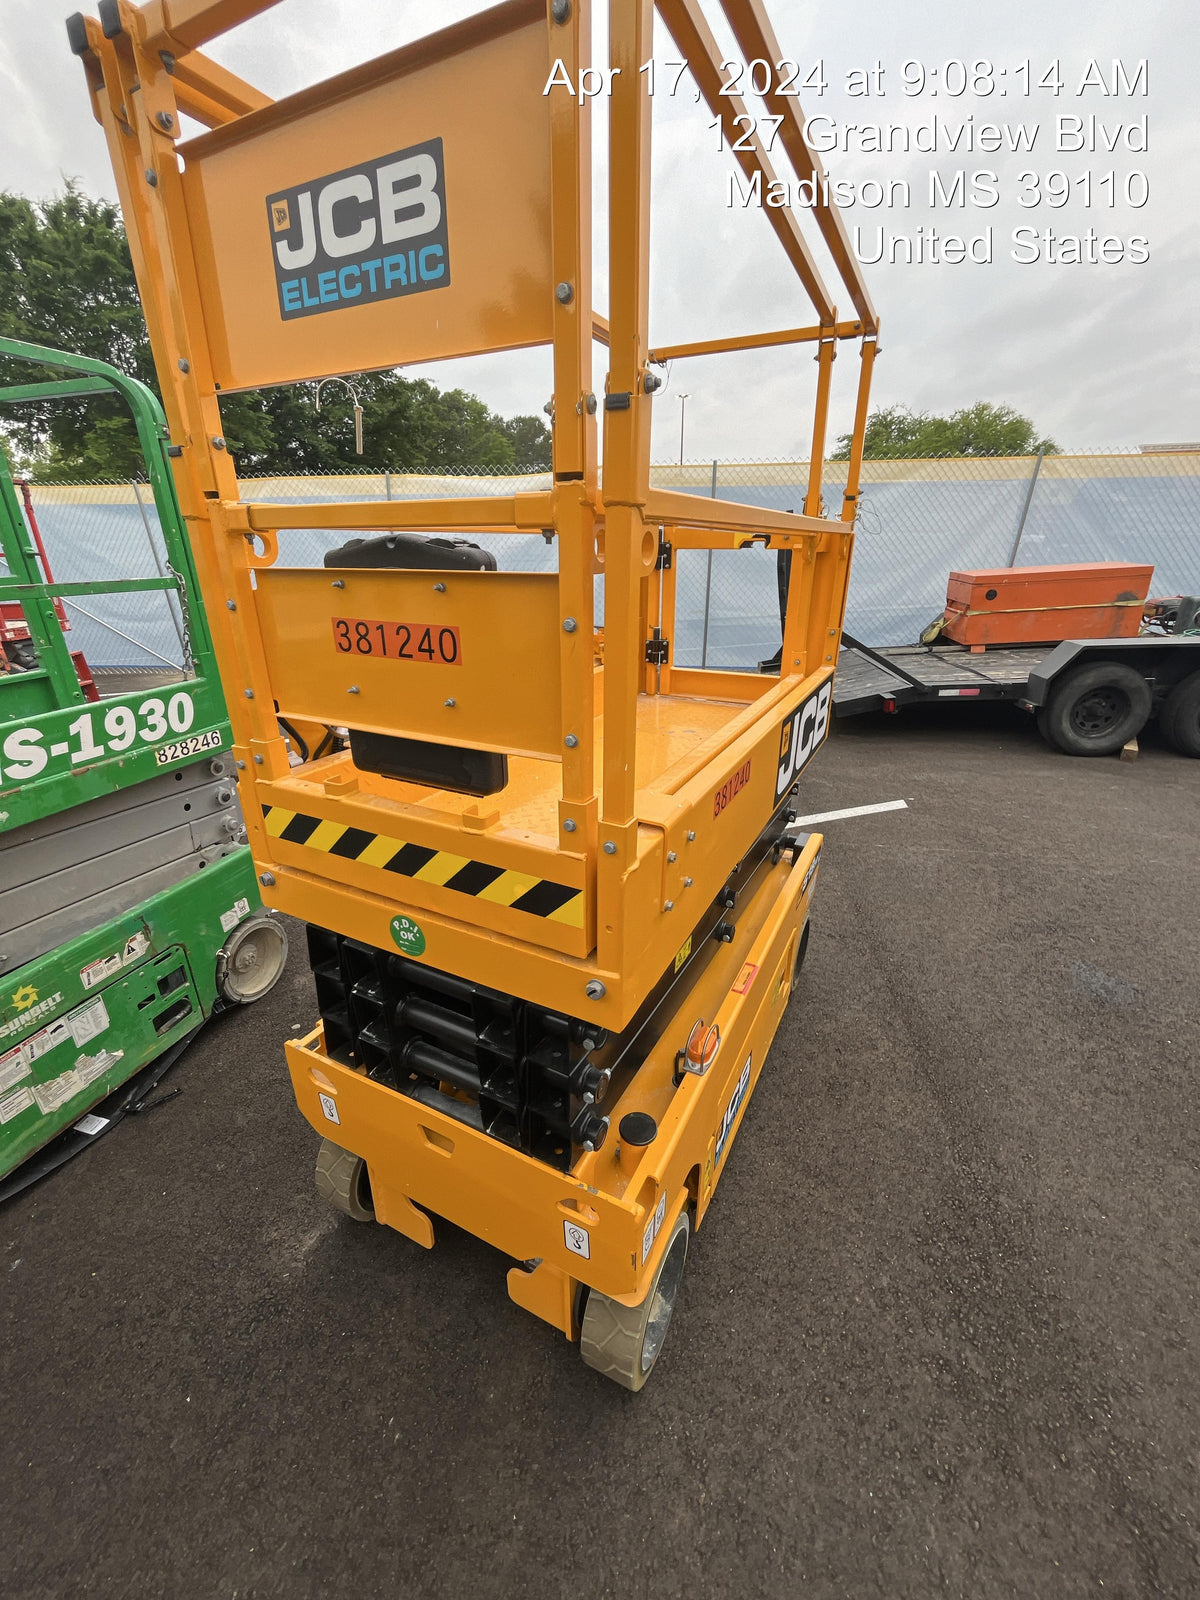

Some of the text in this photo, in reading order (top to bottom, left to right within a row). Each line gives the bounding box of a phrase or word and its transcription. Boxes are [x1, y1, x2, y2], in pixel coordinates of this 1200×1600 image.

[275, 153, 442, 270] JCB
[281, 244, 445, 311] ELECTRIC
[336, 620, 458, 663] 381240
[0, 692, 195, 786] S-1930
[157, 731, 221, 764] 828246
[777, 681, 832, 795] JCB
[714, 760, 751, 817] 381240
[400, 930, 415, 941] OK
[0, 991, 64, 1038] SUNBELT
